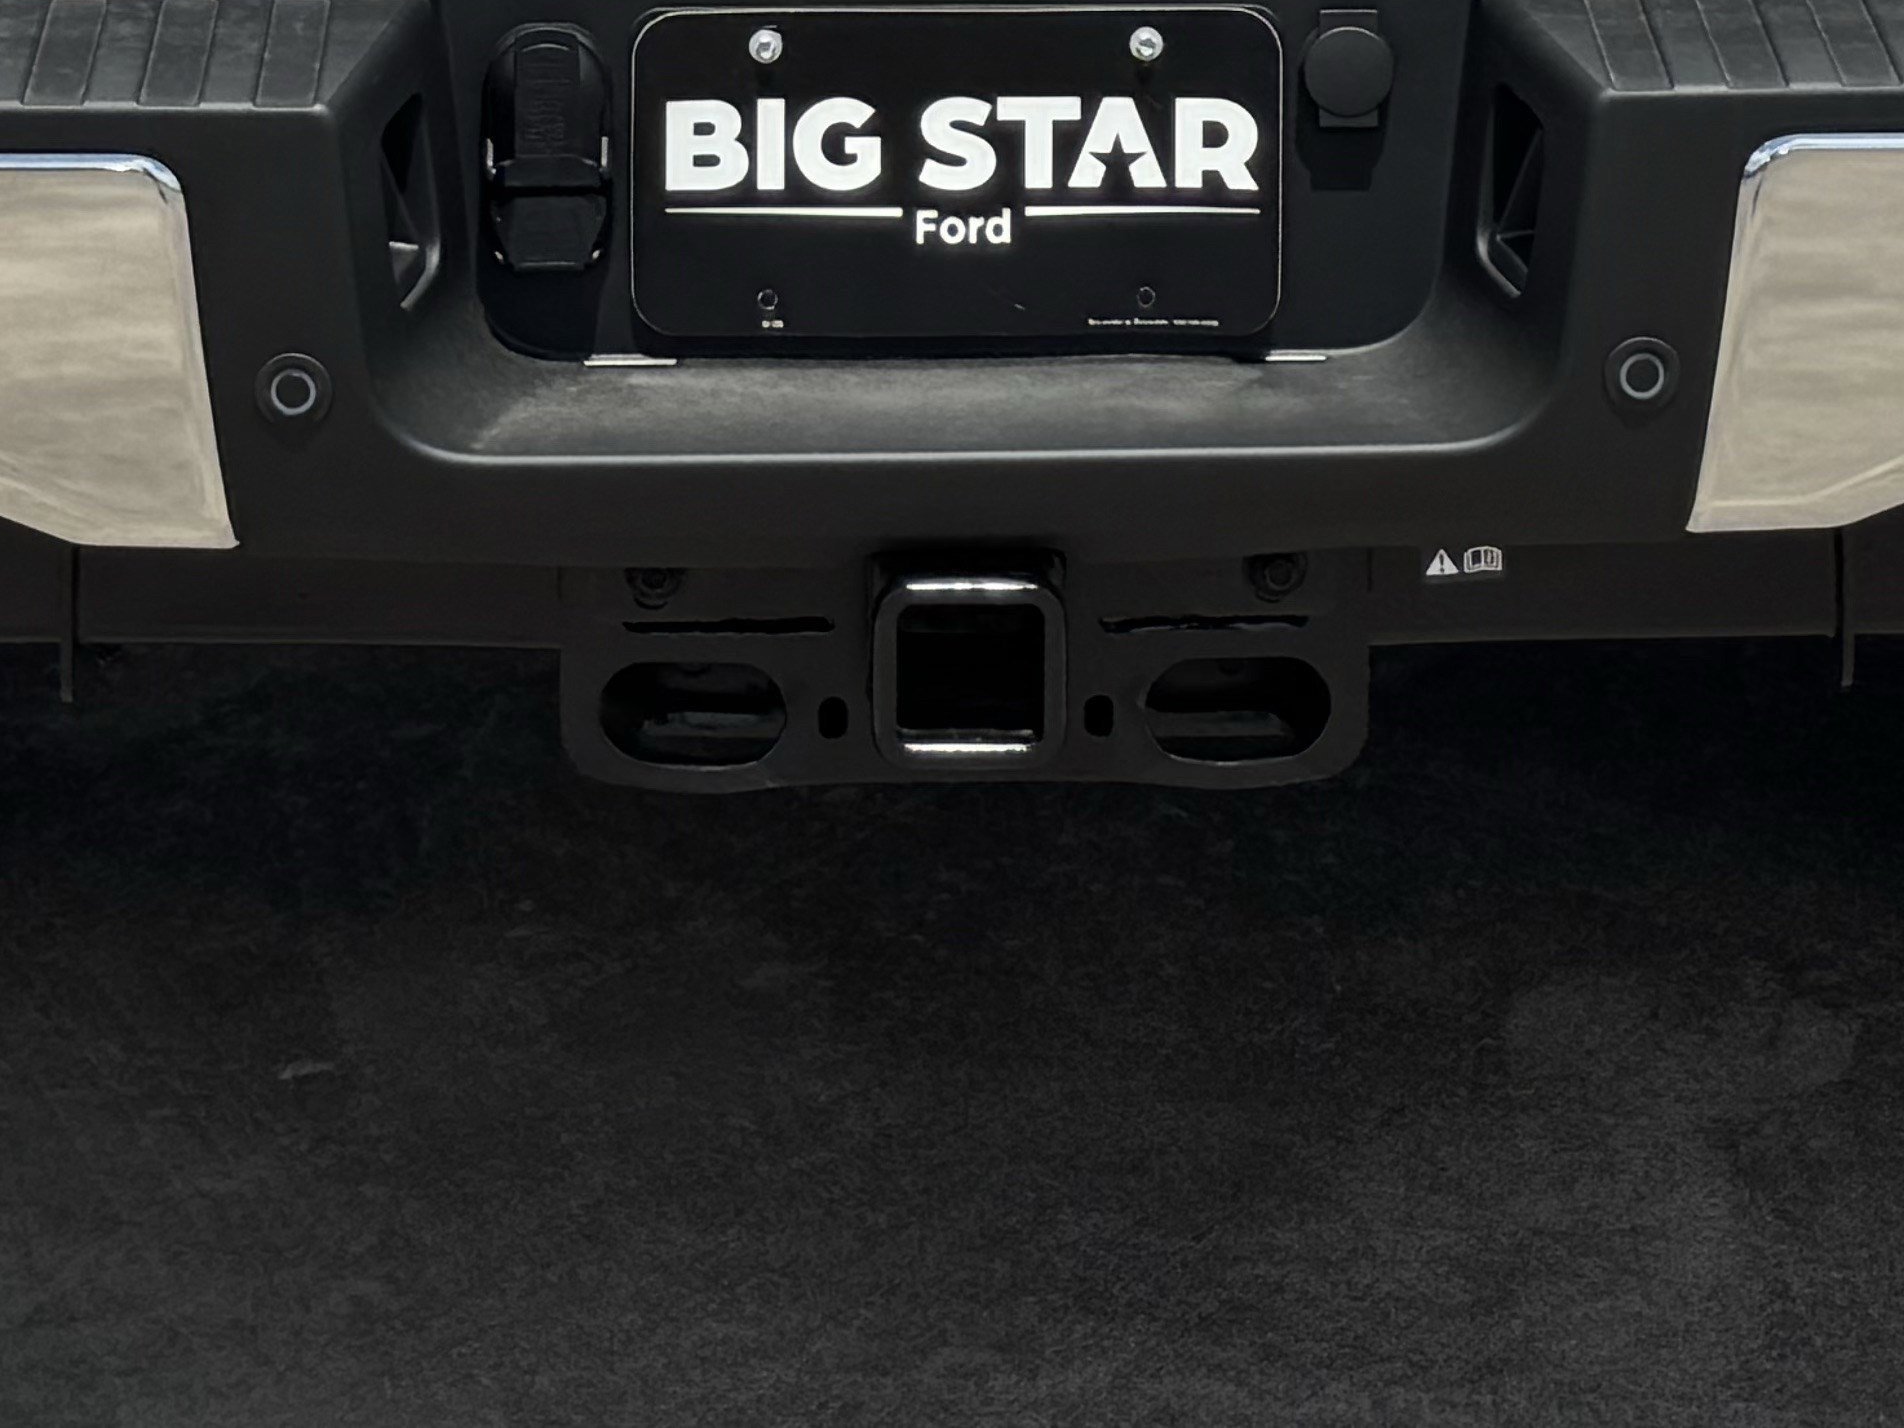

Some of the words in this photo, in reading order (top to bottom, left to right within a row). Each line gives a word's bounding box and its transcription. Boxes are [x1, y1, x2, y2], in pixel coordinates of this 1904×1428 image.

[665, 97, 882, 191] BIG
[918, 96, 1259, 190] STAR
[915, 207, 1012, 245] Ford
